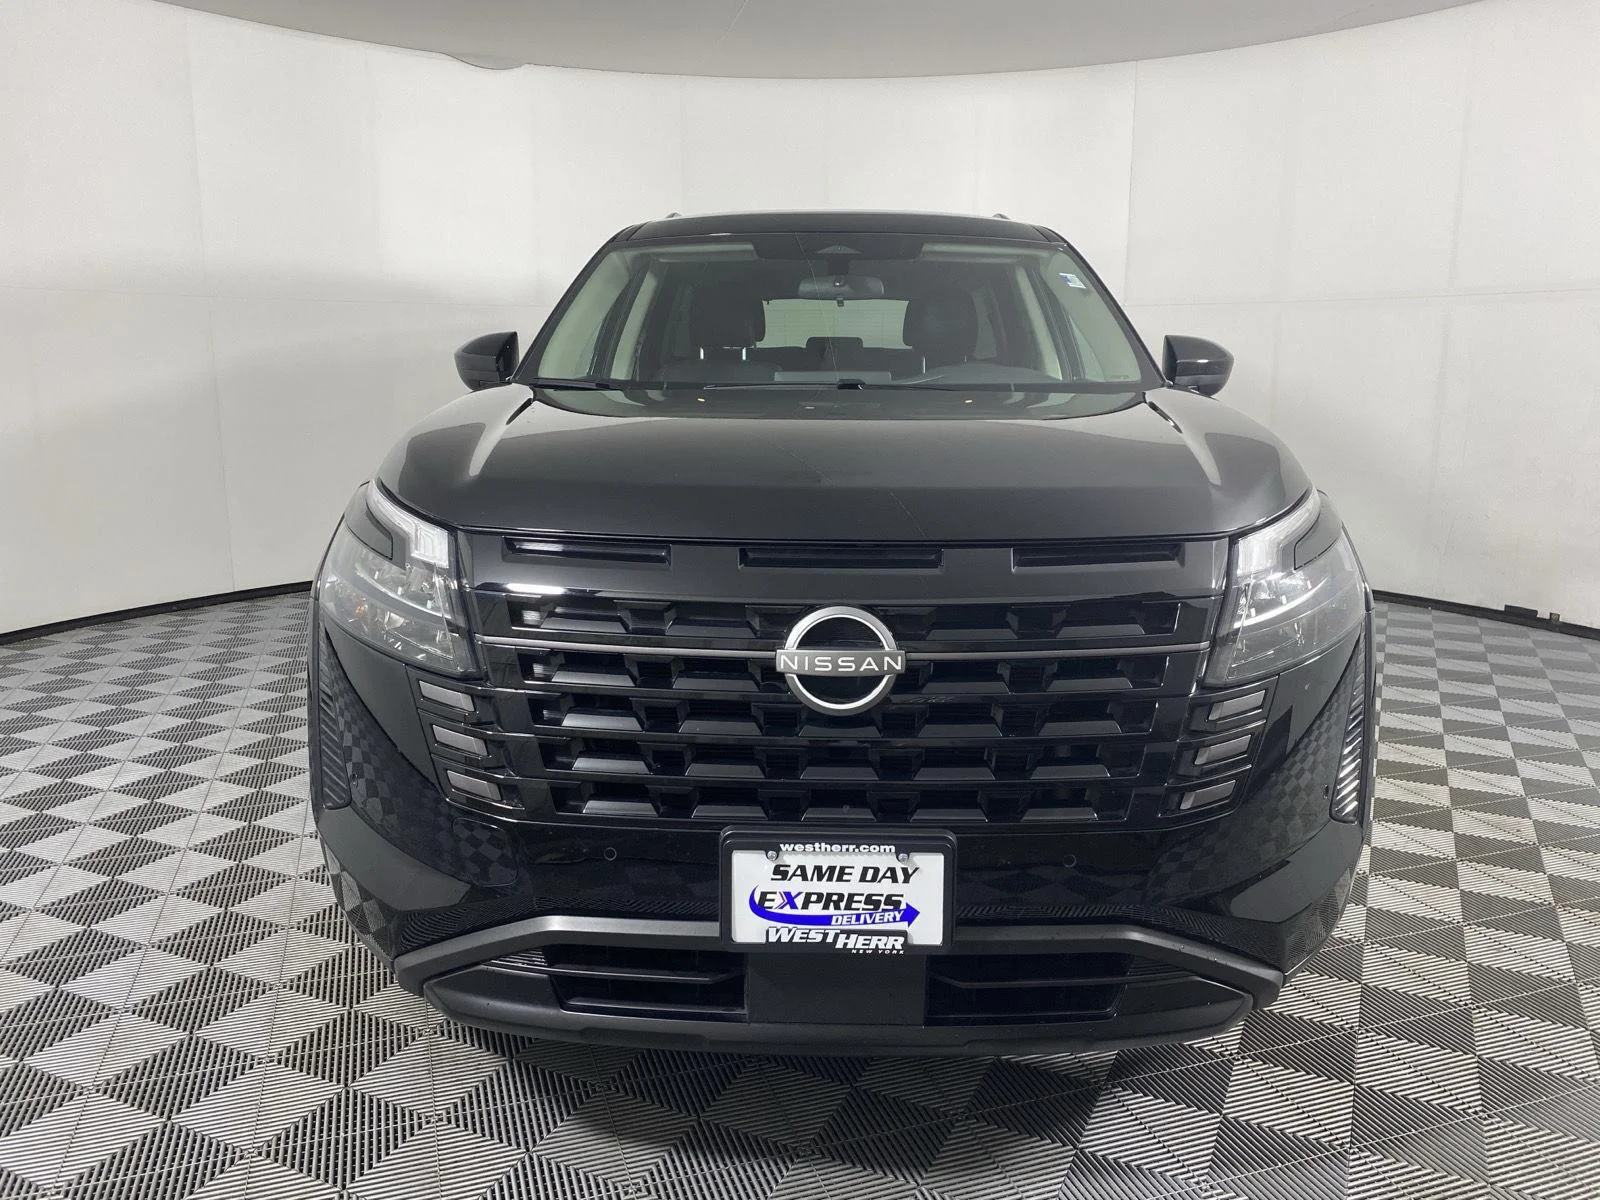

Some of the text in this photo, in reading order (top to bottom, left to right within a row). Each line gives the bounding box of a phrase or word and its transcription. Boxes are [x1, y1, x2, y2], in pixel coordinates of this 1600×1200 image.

[780, 655, 901, 671] NISSAN
[780, 842, 896, 853] westherr.com
[771, 864, 919, 884] SAME DAY
[757, 891, 904, 912] EXPRESS
[831, 911, 904, 926] DELIVERY
